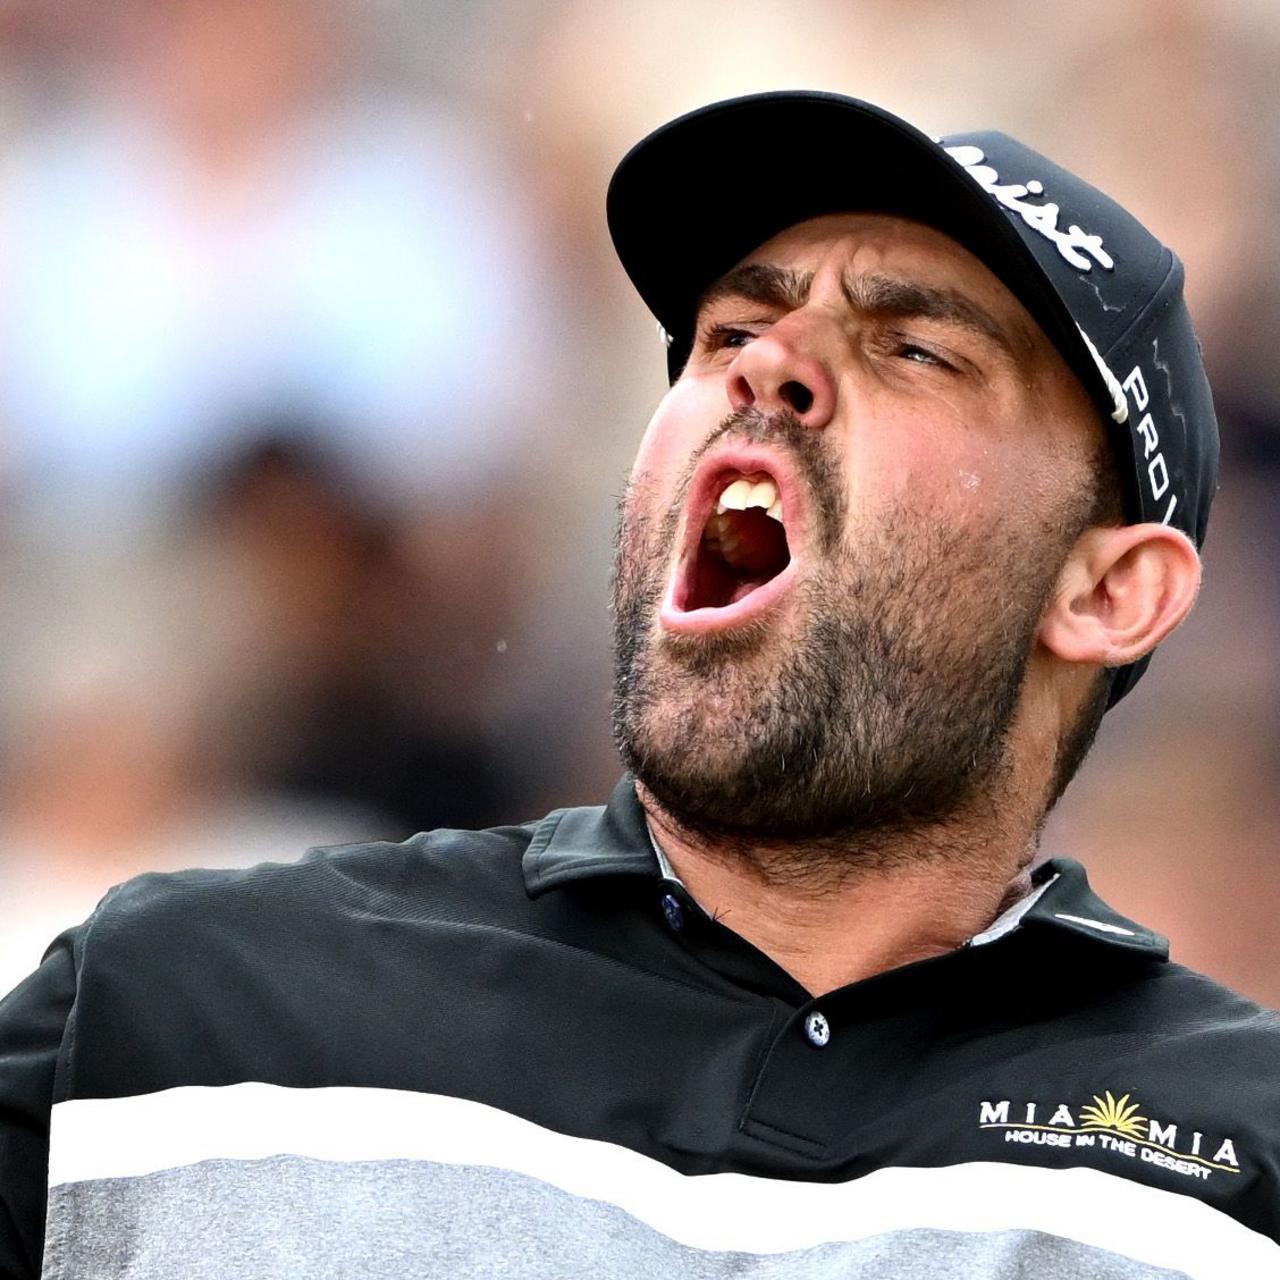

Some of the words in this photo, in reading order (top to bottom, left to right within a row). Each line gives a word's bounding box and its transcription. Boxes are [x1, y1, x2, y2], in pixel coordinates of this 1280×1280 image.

[979, 1101, 1075, 1127] MIA
[1148, 1119, 1239, 1166] MIA
[1005, 1130, 1071, 1148] HOUSE
[1076, 1134, 1095, 1147] IN
[1099, 1134, 1136, 1158] THE
[1140, 1146, 1212, 1179] DESERT
